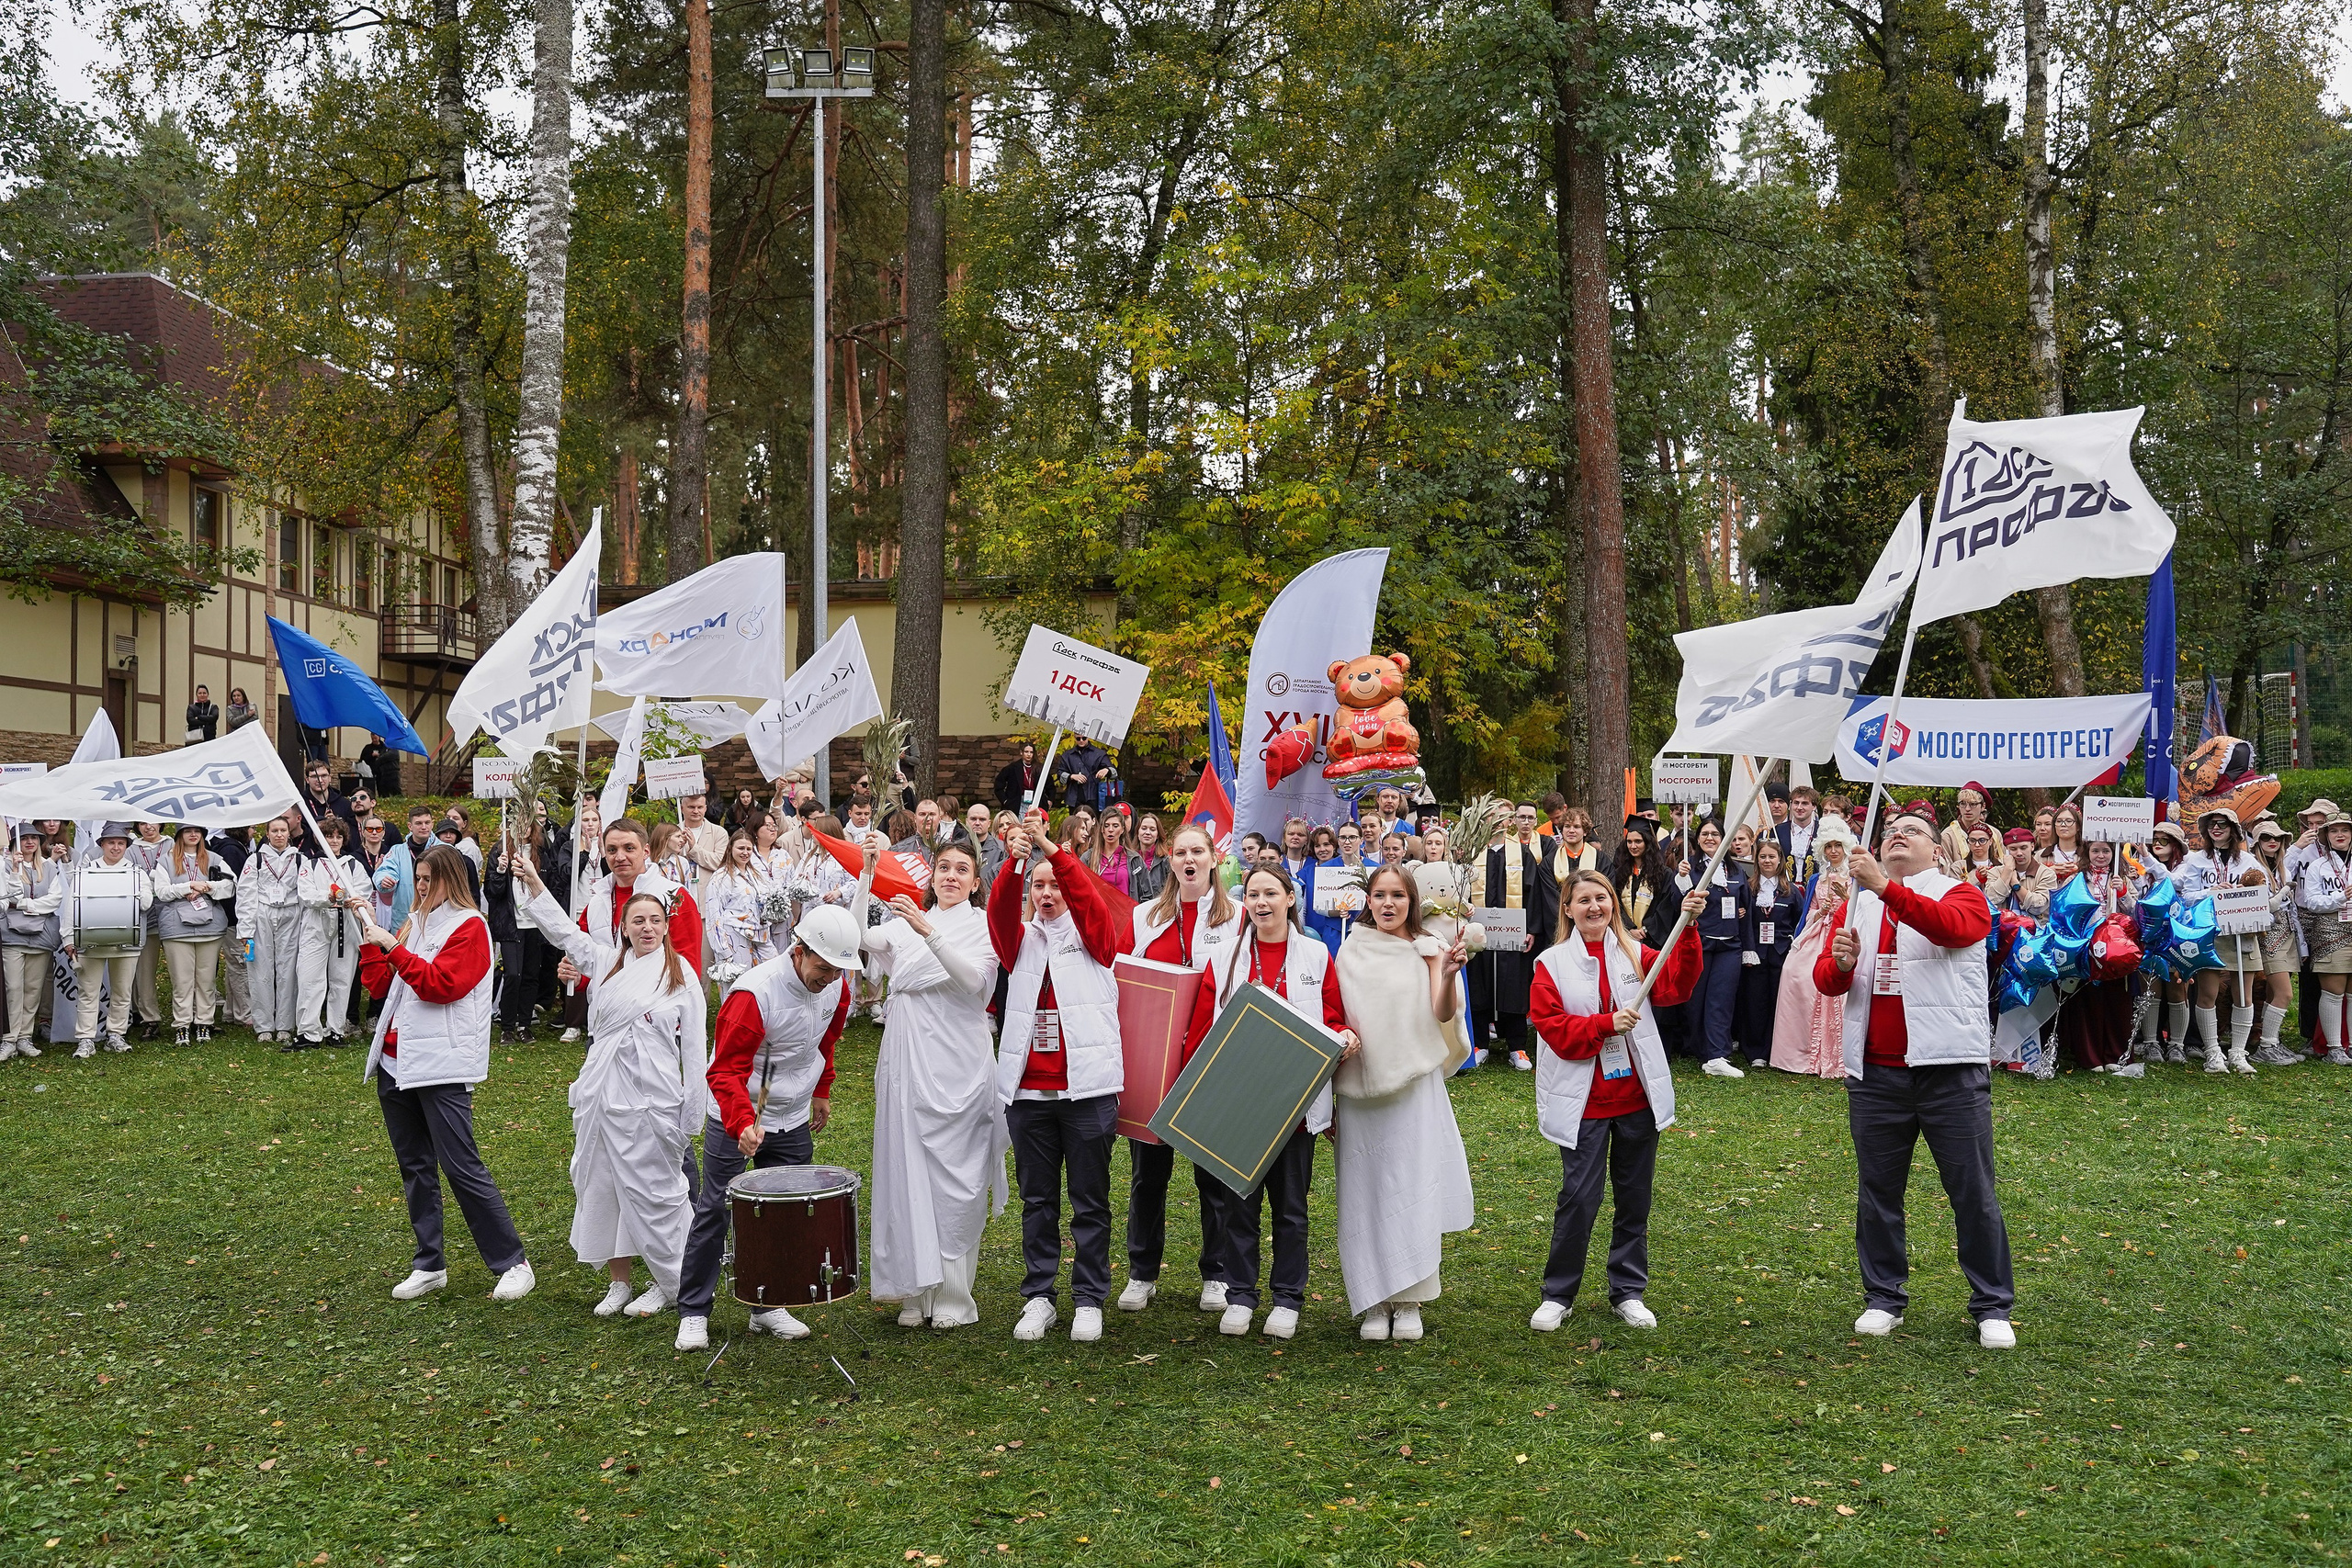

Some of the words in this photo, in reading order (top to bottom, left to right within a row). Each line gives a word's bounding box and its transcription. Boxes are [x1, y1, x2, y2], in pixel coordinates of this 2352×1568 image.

[1059, 675, 1106, 702] ДСК
[1354, 715, 1378, 725] love
[1358, 722, 1380, 735] you
[1917, 728, 2114, 760] МОСГОРГЕОТРЕСТ
[2086, 816, 2151, 824] МОСГОРГЕОТРЕСТ
